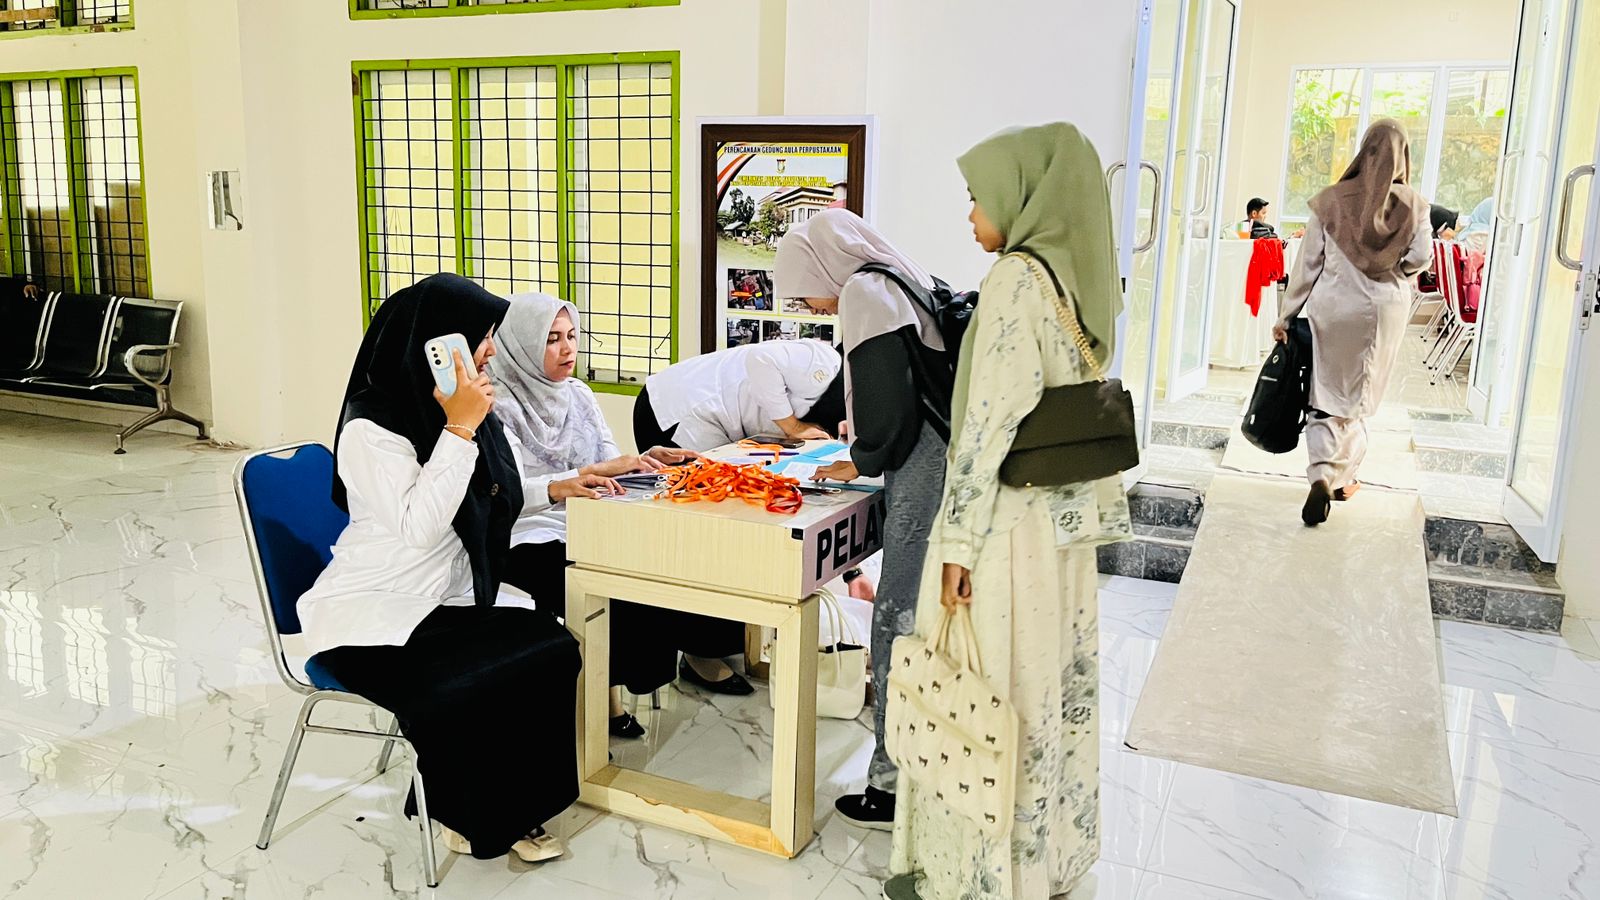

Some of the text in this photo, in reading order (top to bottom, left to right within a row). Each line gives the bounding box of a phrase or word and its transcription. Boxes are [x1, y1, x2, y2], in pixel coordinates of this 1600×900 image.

[723, 145, 842, 154] PERENCANAAN GEDUNG AULA PERPUSTAKAAN
